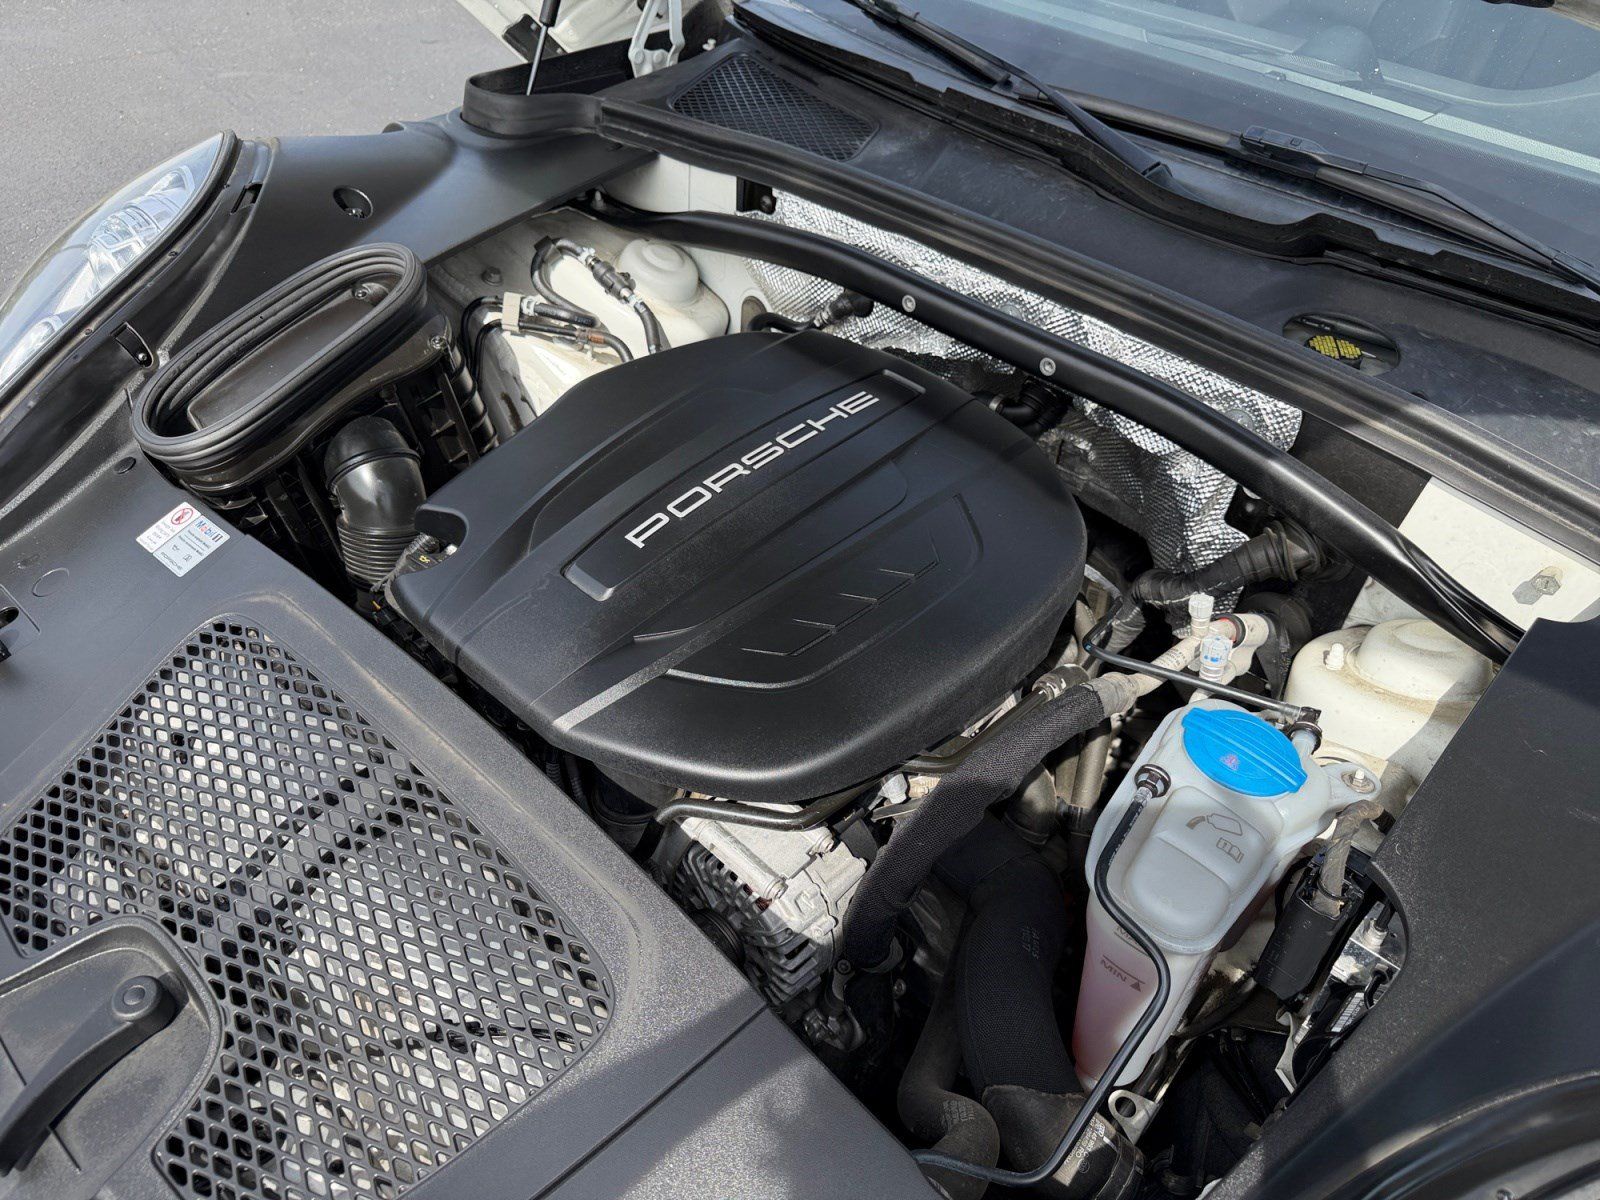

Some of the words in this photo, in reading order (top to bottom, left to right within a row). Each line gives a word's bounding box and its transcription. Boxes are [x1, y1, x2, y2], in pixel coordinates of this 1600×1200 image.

[624, 391, 880, 549] PORSCHE
[195, 519, 218, 538] Mobil
[1101, 959, 1127, 982] MIN
